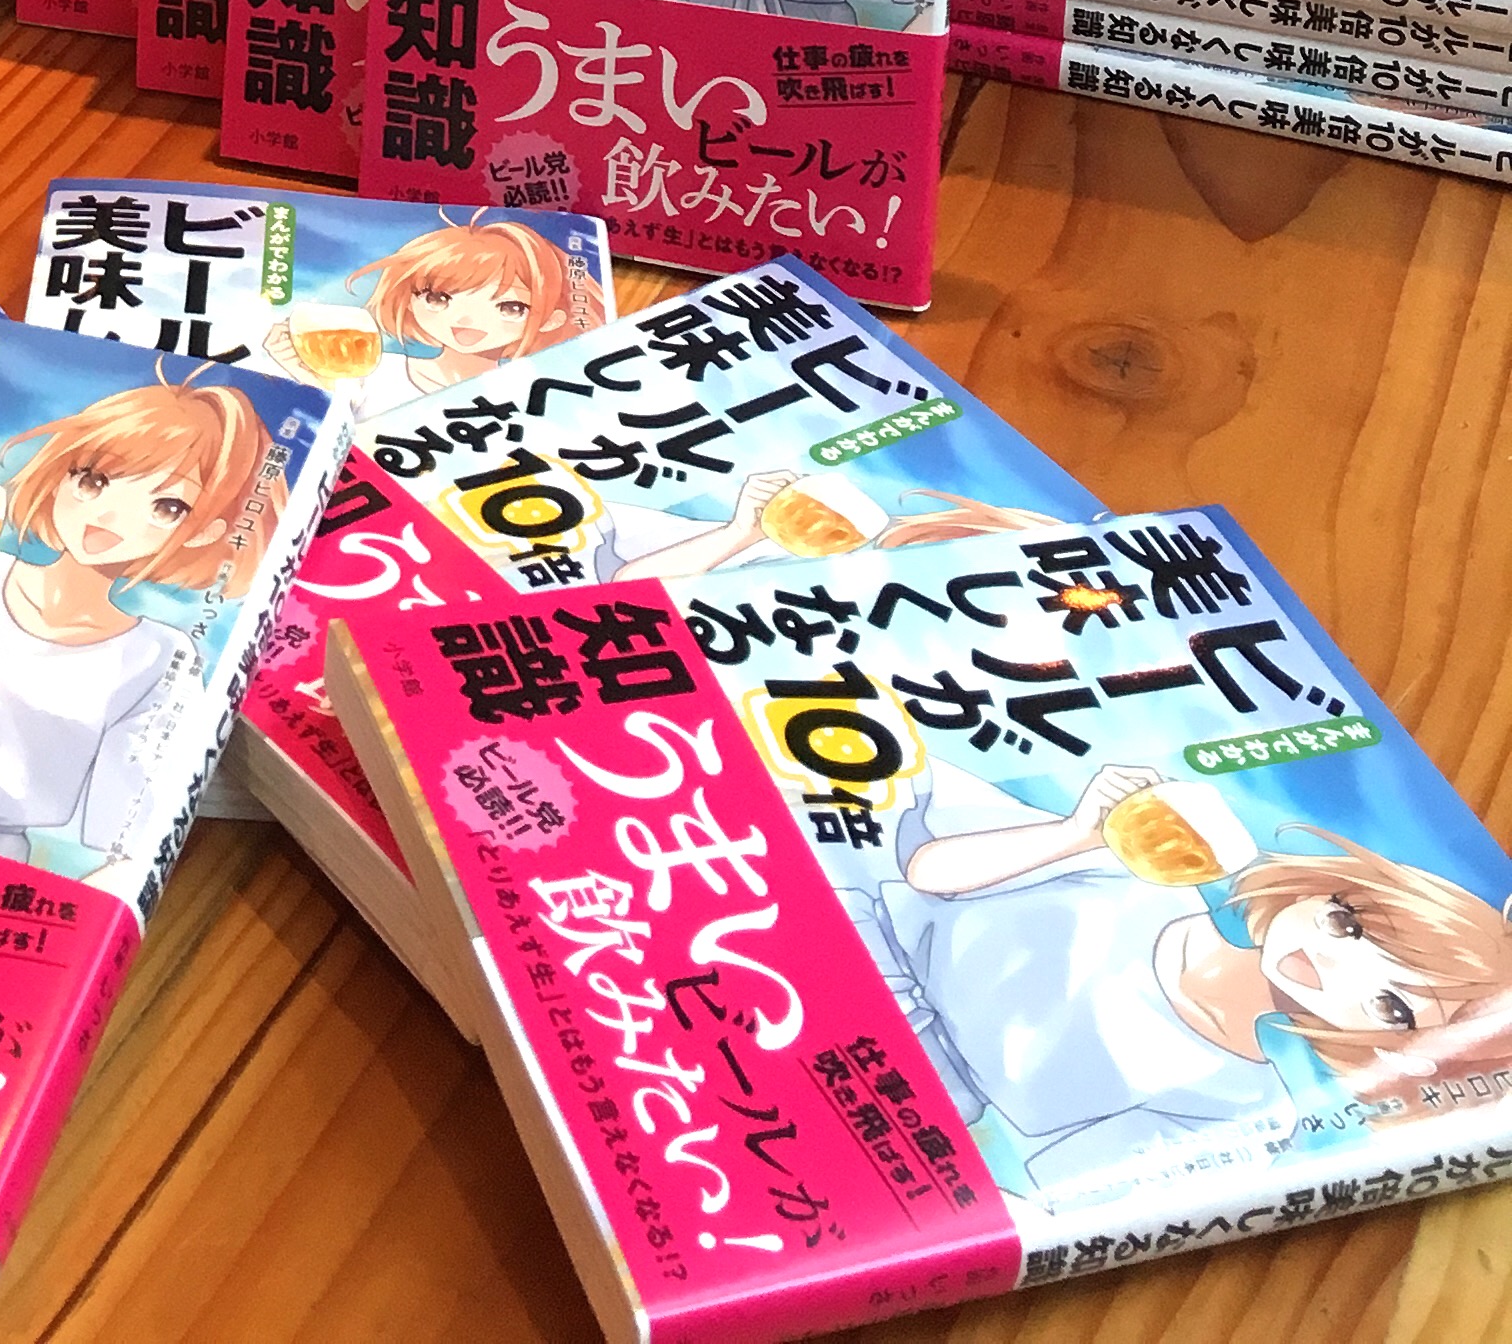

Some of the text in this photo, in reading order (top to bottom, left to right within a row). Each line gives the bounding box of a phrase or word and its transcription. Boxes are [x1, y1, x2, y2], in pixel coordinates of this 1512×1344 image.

[772, 43, 910, 75] 仕事の疲れを
[776, 75, 896, 104] 吹き飛ばす!
[249, 129, 300, 150] 小学館
[489, 152, 571, 184] ビール党
[696, 115, 908, 189] ビールが
[600, 136, 901, 250] 飲みたい!
[269, 205, 291, 300] まんがでわかる
[227, 441, 289, 551] 藤原ヒロユキ
[452, 336, 925, 591] ビールが10倍
[382, 642, 425, 698] 小学館
[433, 520, 1252, 725] 美味しくなる知識
[764, 613, 1351, 850] ビールが10倍
[1197, 721, 1376, 770] まんがでわかる
[451, 762, 535, 840] 必読!!
[479, 740, 569, 837] ビール党
[554, 710, 806, 1055] うまい
[526, 869, 787, 1255] 飲みたい!
[664, 965, 847, 1250] ビールが
[811, 1052, 925, 1203] 吹き飛ばす!
[842, 1037, 978, 1211] 仕事の疲れを
